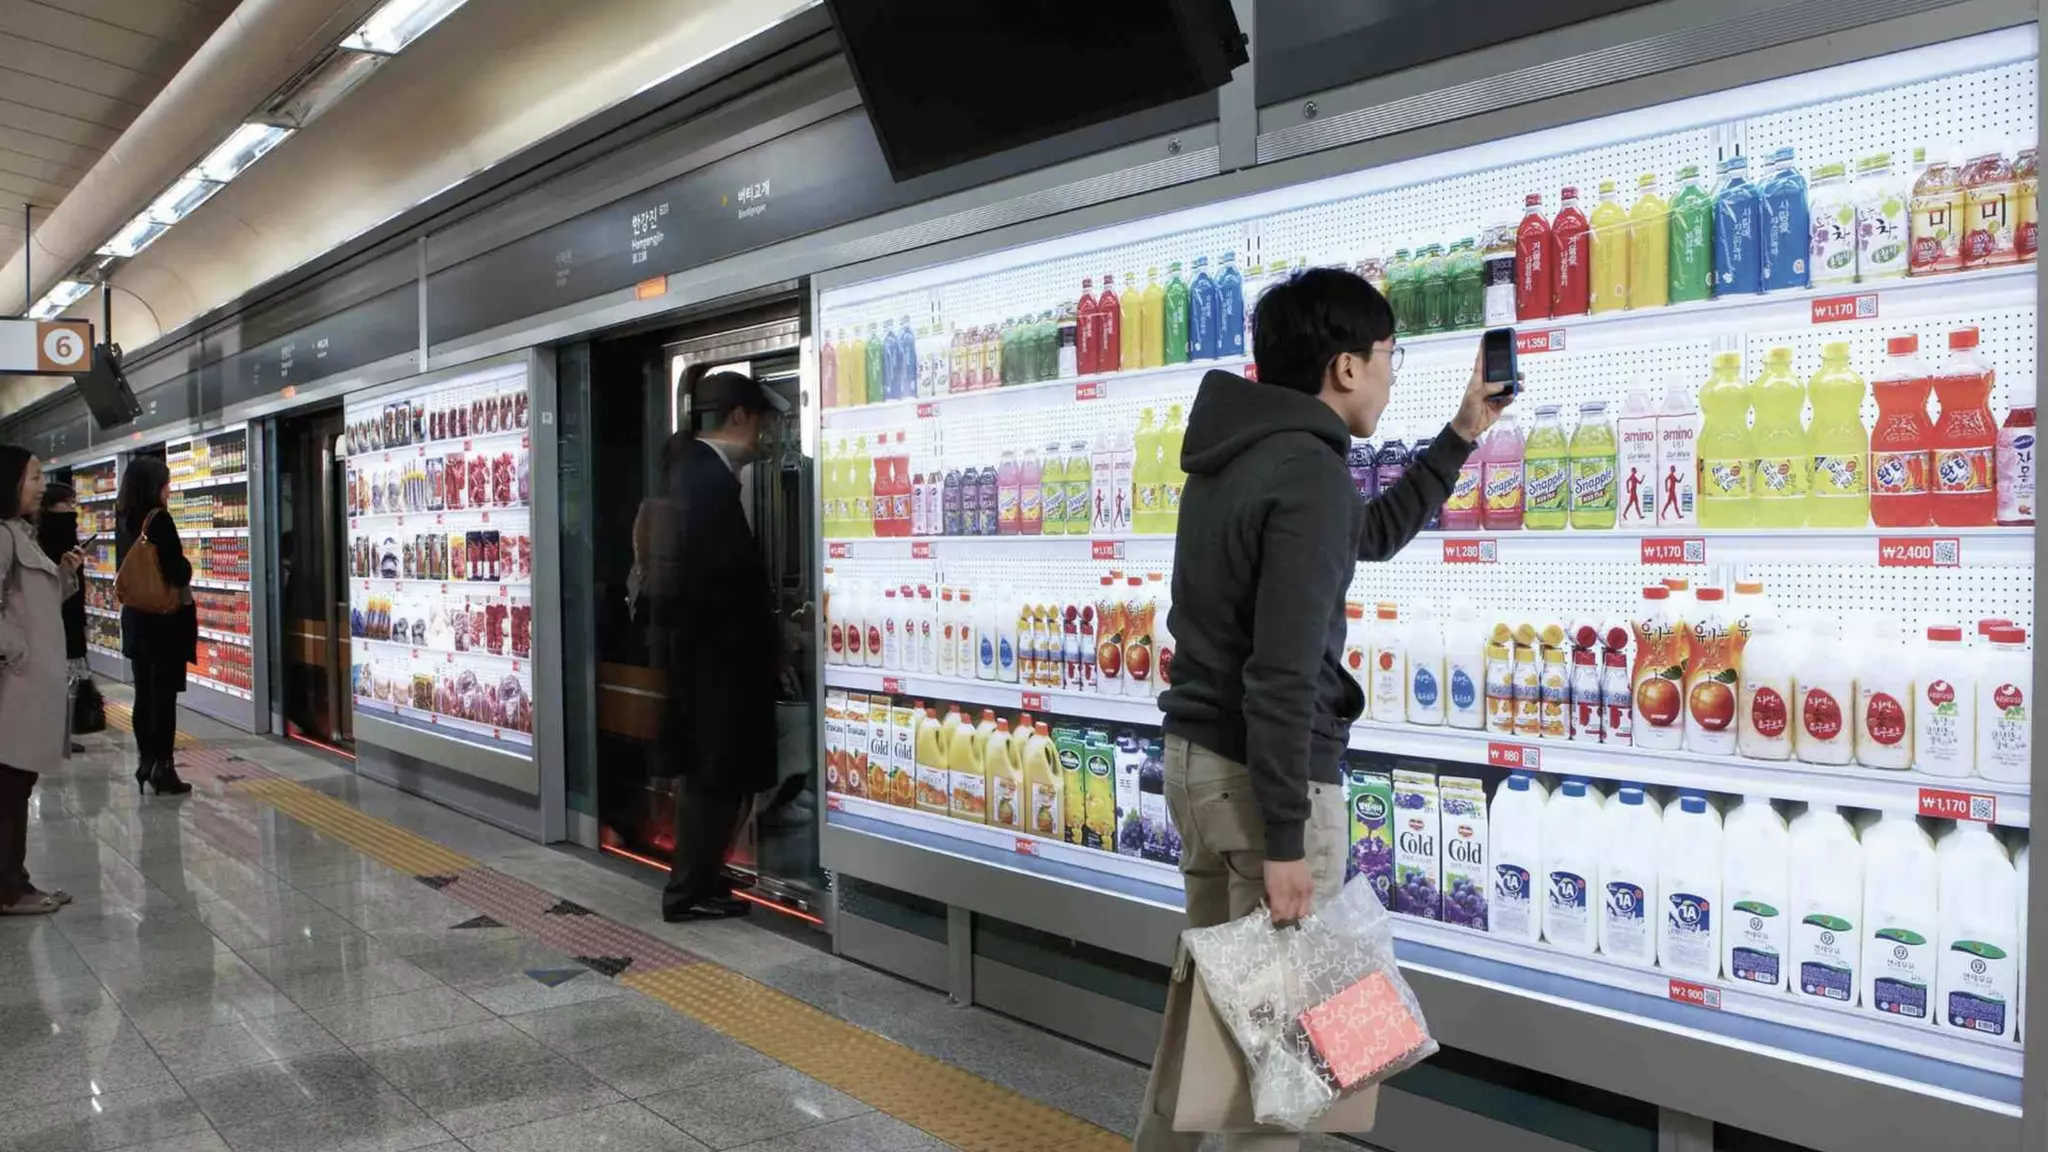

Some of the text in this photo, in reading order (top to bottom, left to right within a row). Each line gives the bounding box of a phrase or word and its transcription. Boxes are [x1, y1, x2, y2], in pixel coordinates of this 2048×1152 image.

[738, 179, 770, 204] 버티고개
[632, 206, 658, 235] 한강진
[1815, 303, 1853, 318] ₩1,170
[56, 336, 72, 357] 6
[1624, 431, 1654, 443] amino
[1663, 428, 1693, 441] amino
[1487, 472, 1520, 496] Snapple
[1528, 468, 1566, 496] Snapple
[1575, 466, 1614, 495] Snapple
[1644, 545, 1681, 559] ₩1,170
[1882, 546, 1931, 560] ₩2,400
[871, 739, 889, 756] Cold
[895, 742, 912, 760] Cold
[1922, 796, 1968, 813] ₩1,170
[1400, 831, 1434, 857] Cold
[1448, 838, 1482, 865] Cold
[1507, 875, 1519, 890] 1A
[1562, 882, 1575, 898] 1A
[1618, 893, 1632, 907] 1A
[1682, 905, 1696, 920] 1A
